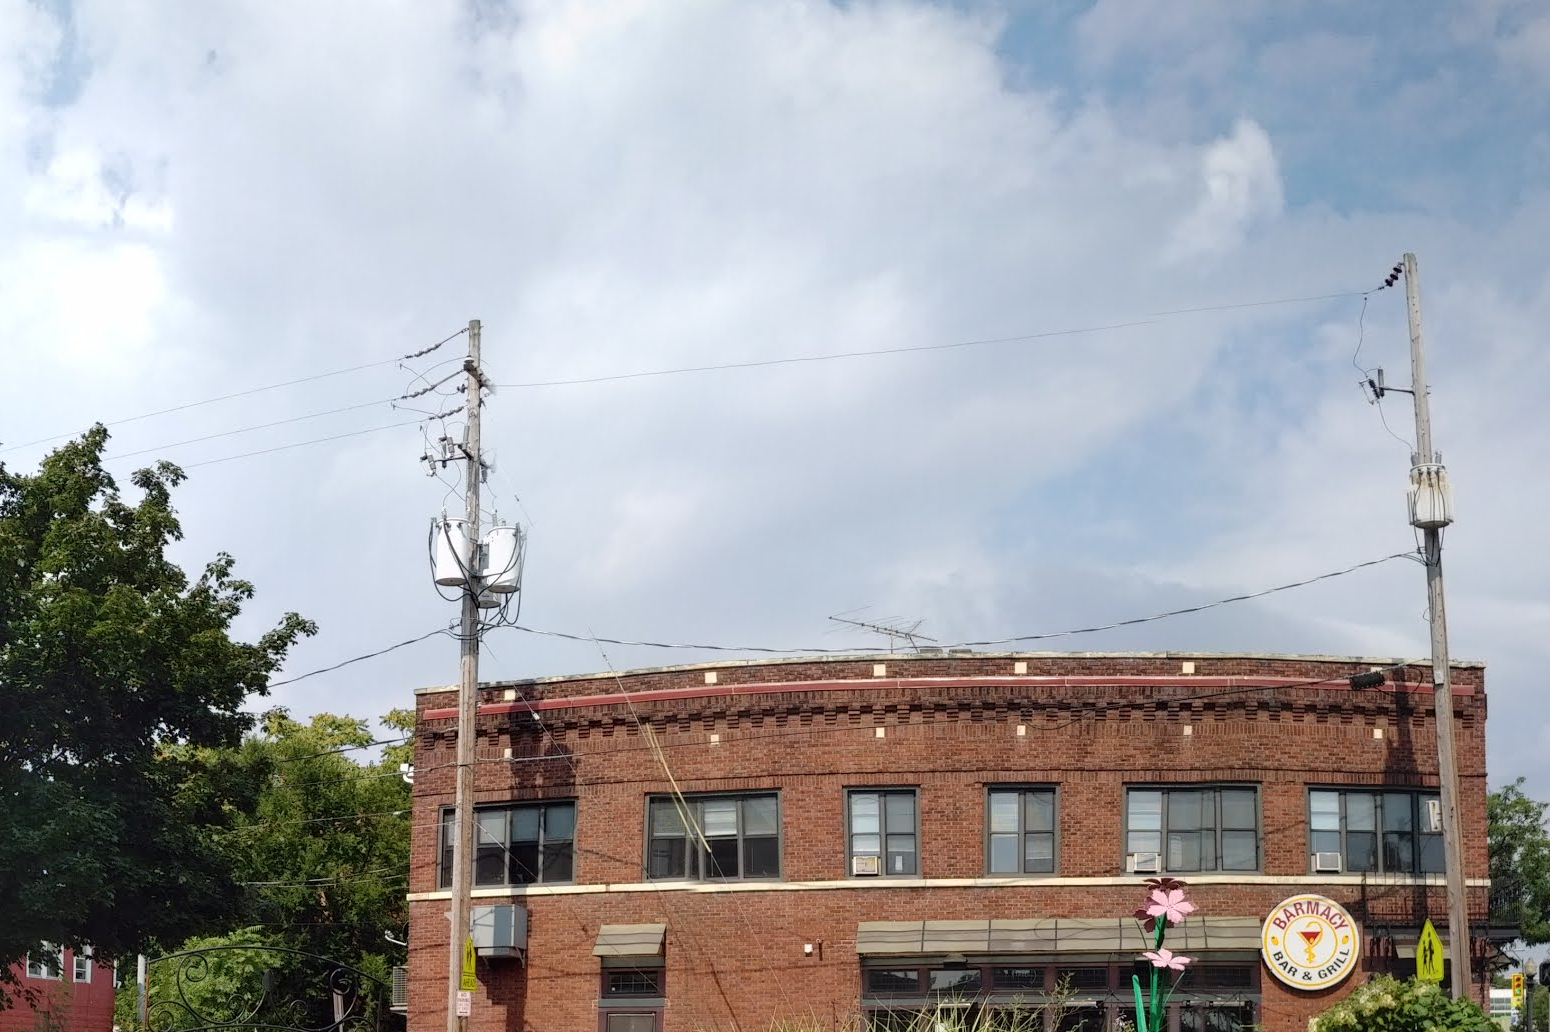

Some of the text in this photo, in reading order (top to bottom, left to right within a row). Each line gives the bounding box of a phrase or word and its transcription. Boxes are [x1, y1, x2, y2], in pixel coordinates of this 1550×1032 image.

[1272, 900, 1349, 931] BARMACY
[1273, 947, 1350, 981] BAR & GRILL
